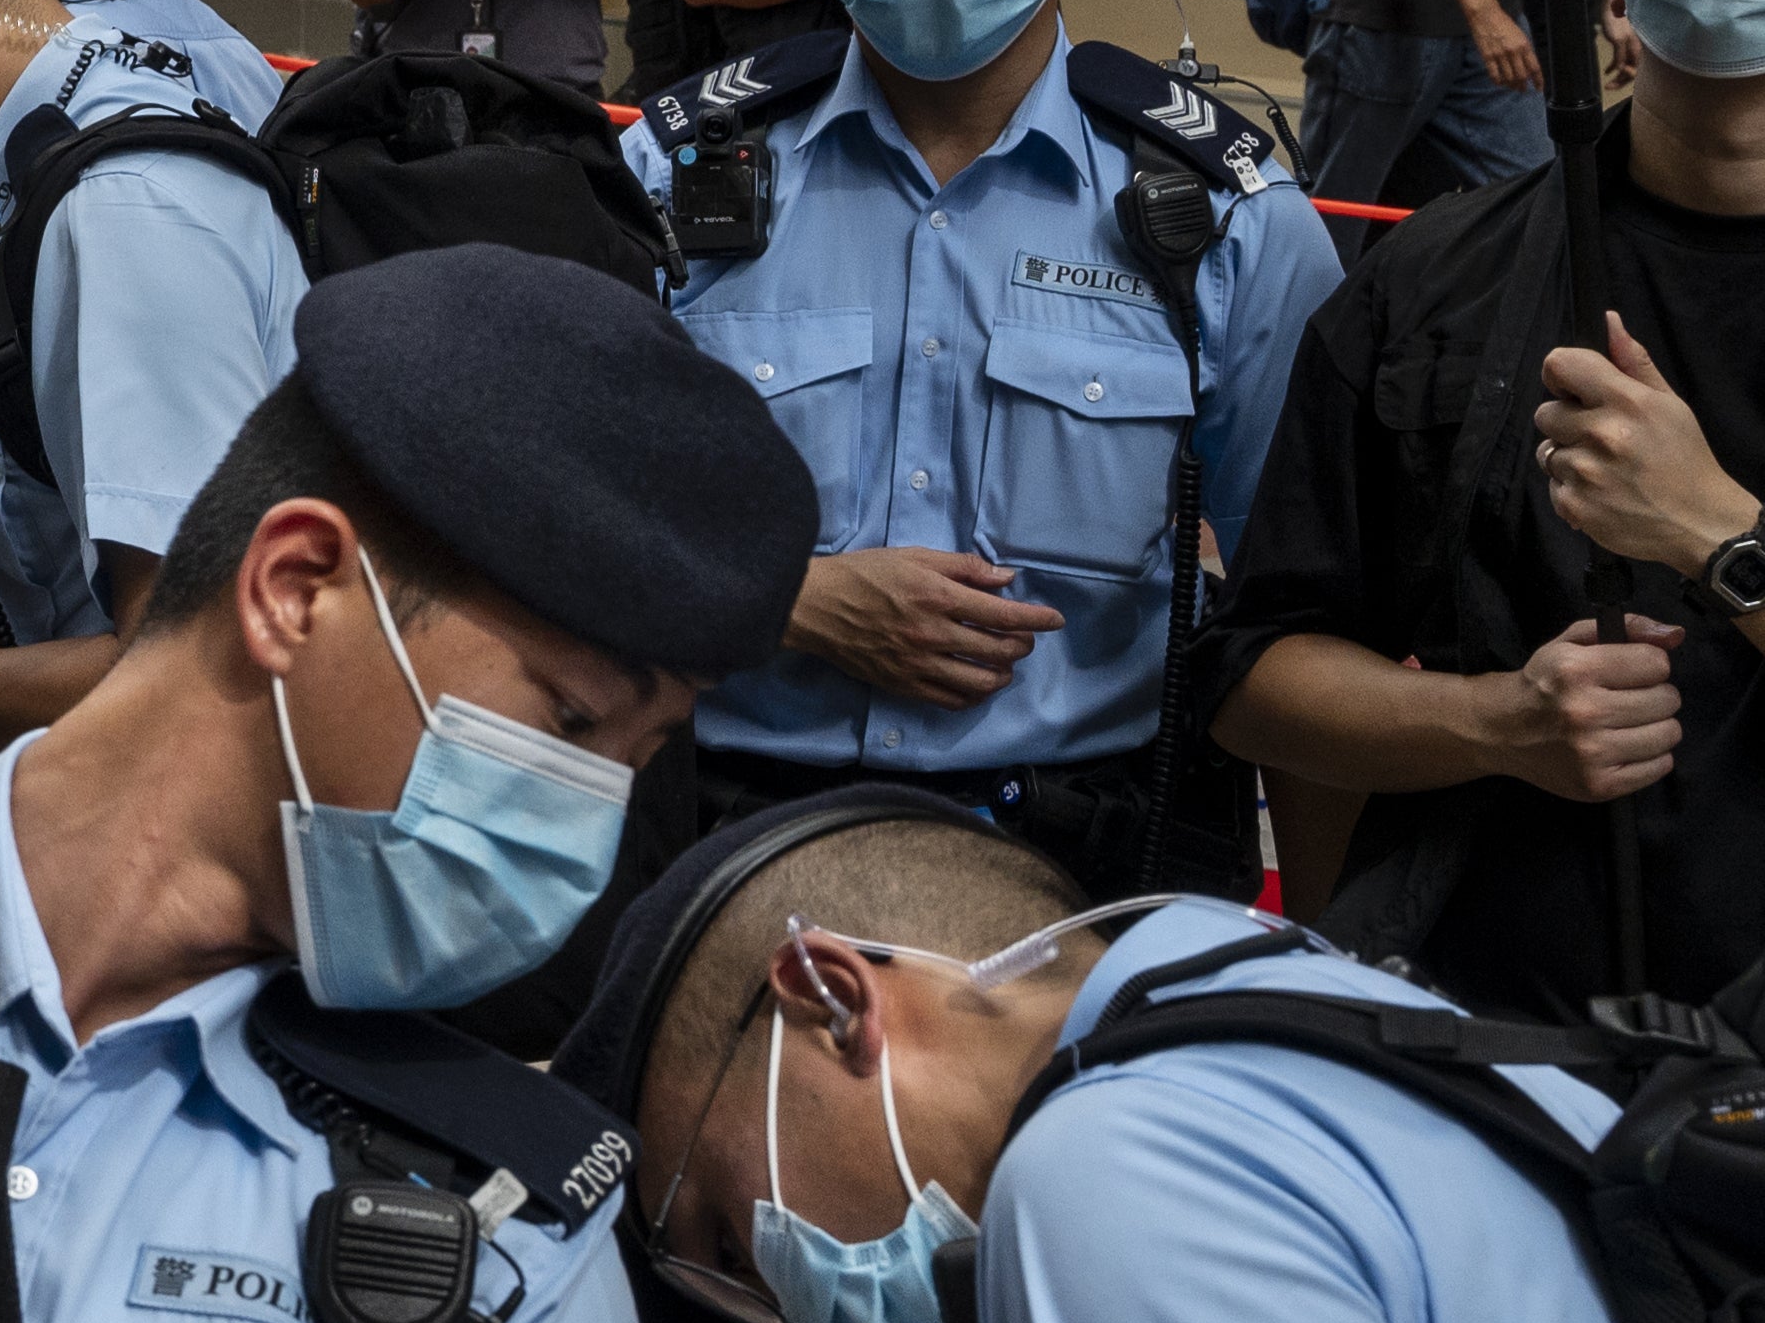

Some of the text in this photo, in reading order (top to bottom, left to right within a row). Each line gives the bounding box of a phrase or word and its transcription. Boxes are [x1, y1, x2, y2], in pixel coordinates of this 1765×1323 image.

[1025, 256, 1049, 283] 警
[1054, 264, 1146, 298] POLICE
[561, 1129, 635, 1211] 27099
[376, 1203, 455, 1224] MOTOROLA
[151, 1255, 306, 1320] 警 POLI
